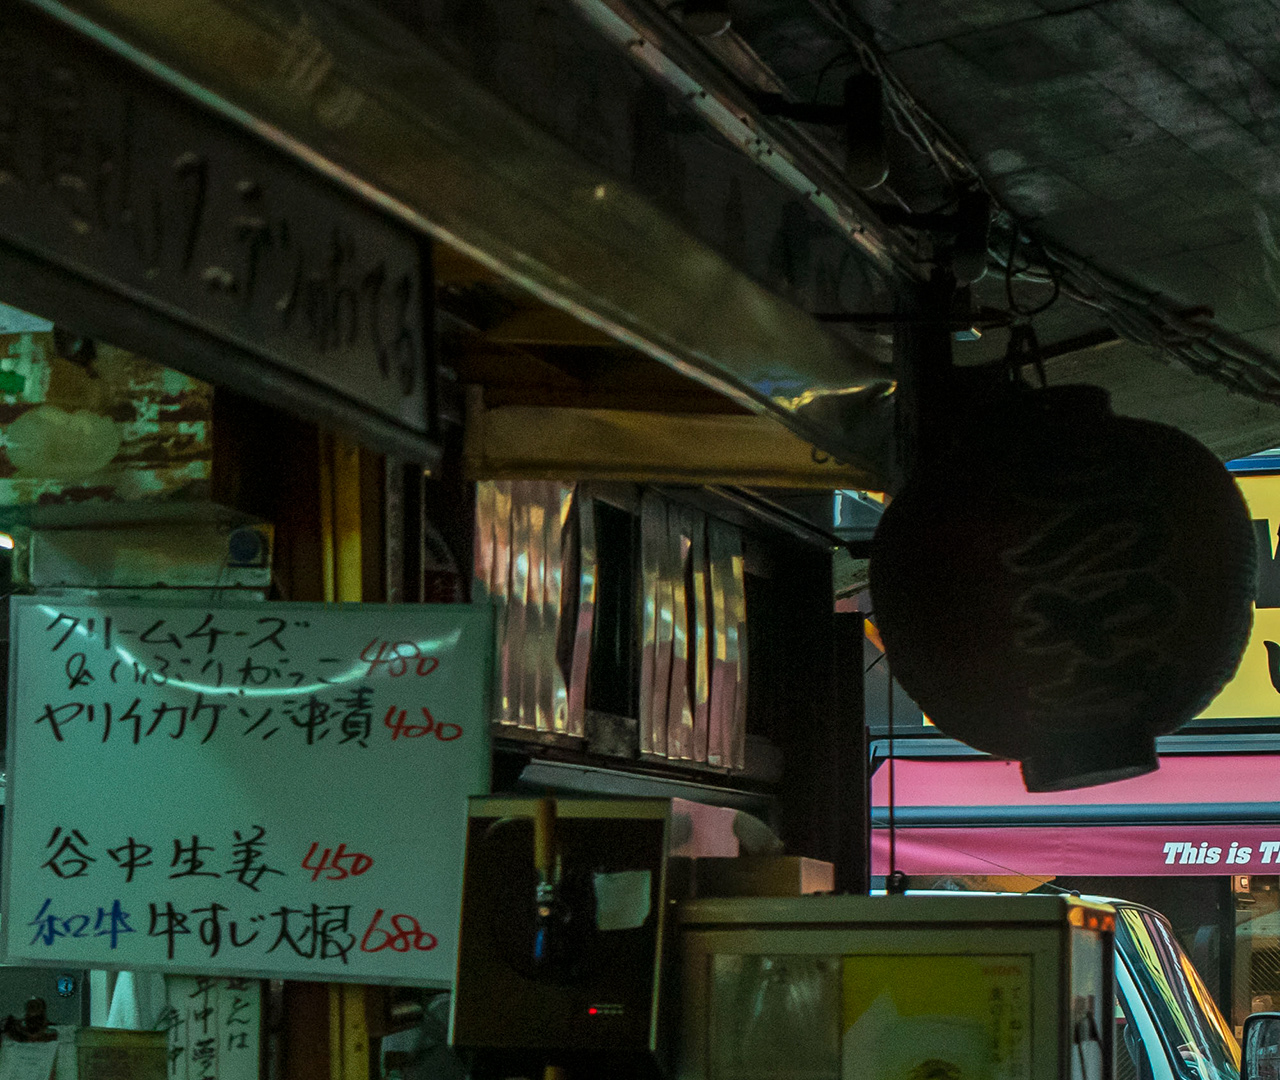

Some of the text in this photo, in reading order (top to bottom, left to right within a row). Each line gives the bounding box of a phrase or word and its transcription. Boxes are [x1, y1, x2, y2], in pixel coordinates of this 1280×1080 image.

[46, 613, 310, 652] クリームチーズ
[41, 825, 374, 892] 谷中生姜 450
[1163, 841, 1222, 865] This
[1225, 841, 1252, 865] is
[359, 908, 438, 954] 680
